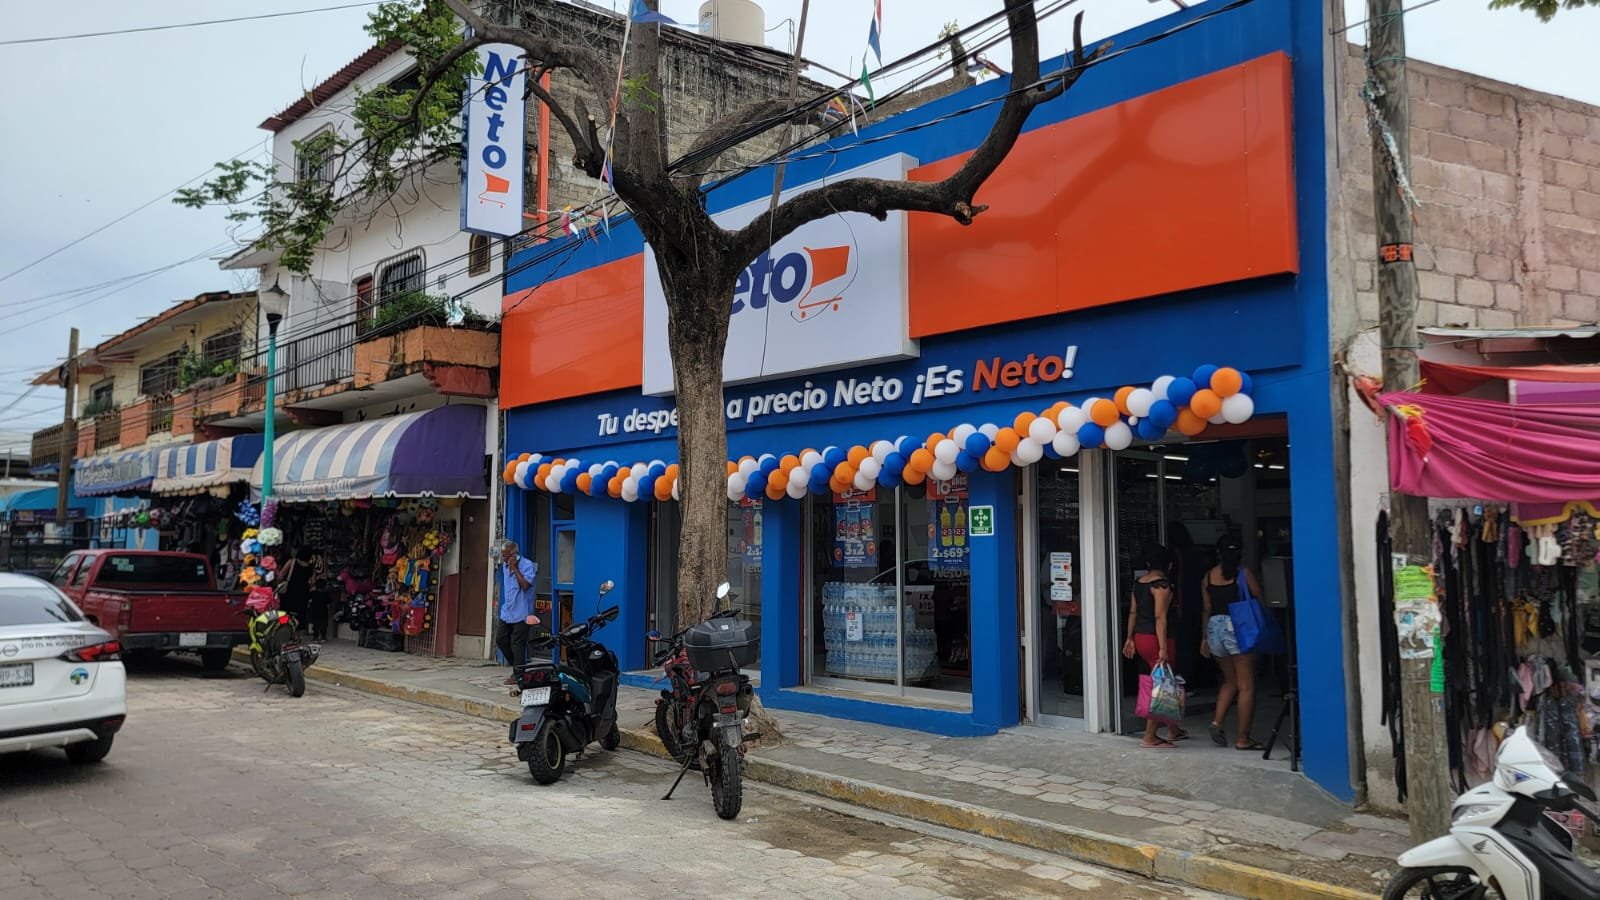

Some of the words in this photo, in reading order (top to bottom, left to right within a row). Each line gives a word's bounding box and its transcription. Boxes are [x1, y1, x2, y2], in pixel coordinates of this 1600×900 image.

[482, 51, 518, 169] Neto
[730, 249, 808, 315] eto
[597, 412, 619, 436] Tu
[726, 399, 743, 420] a
[747, 381, 828, 423] precio
[833, 375, 904, 408] Neto
[911, 365, 965, 405] ¡Es
[972, 345, 1079, 392] Neto!
[845, 543, 865, 556] 3x2
